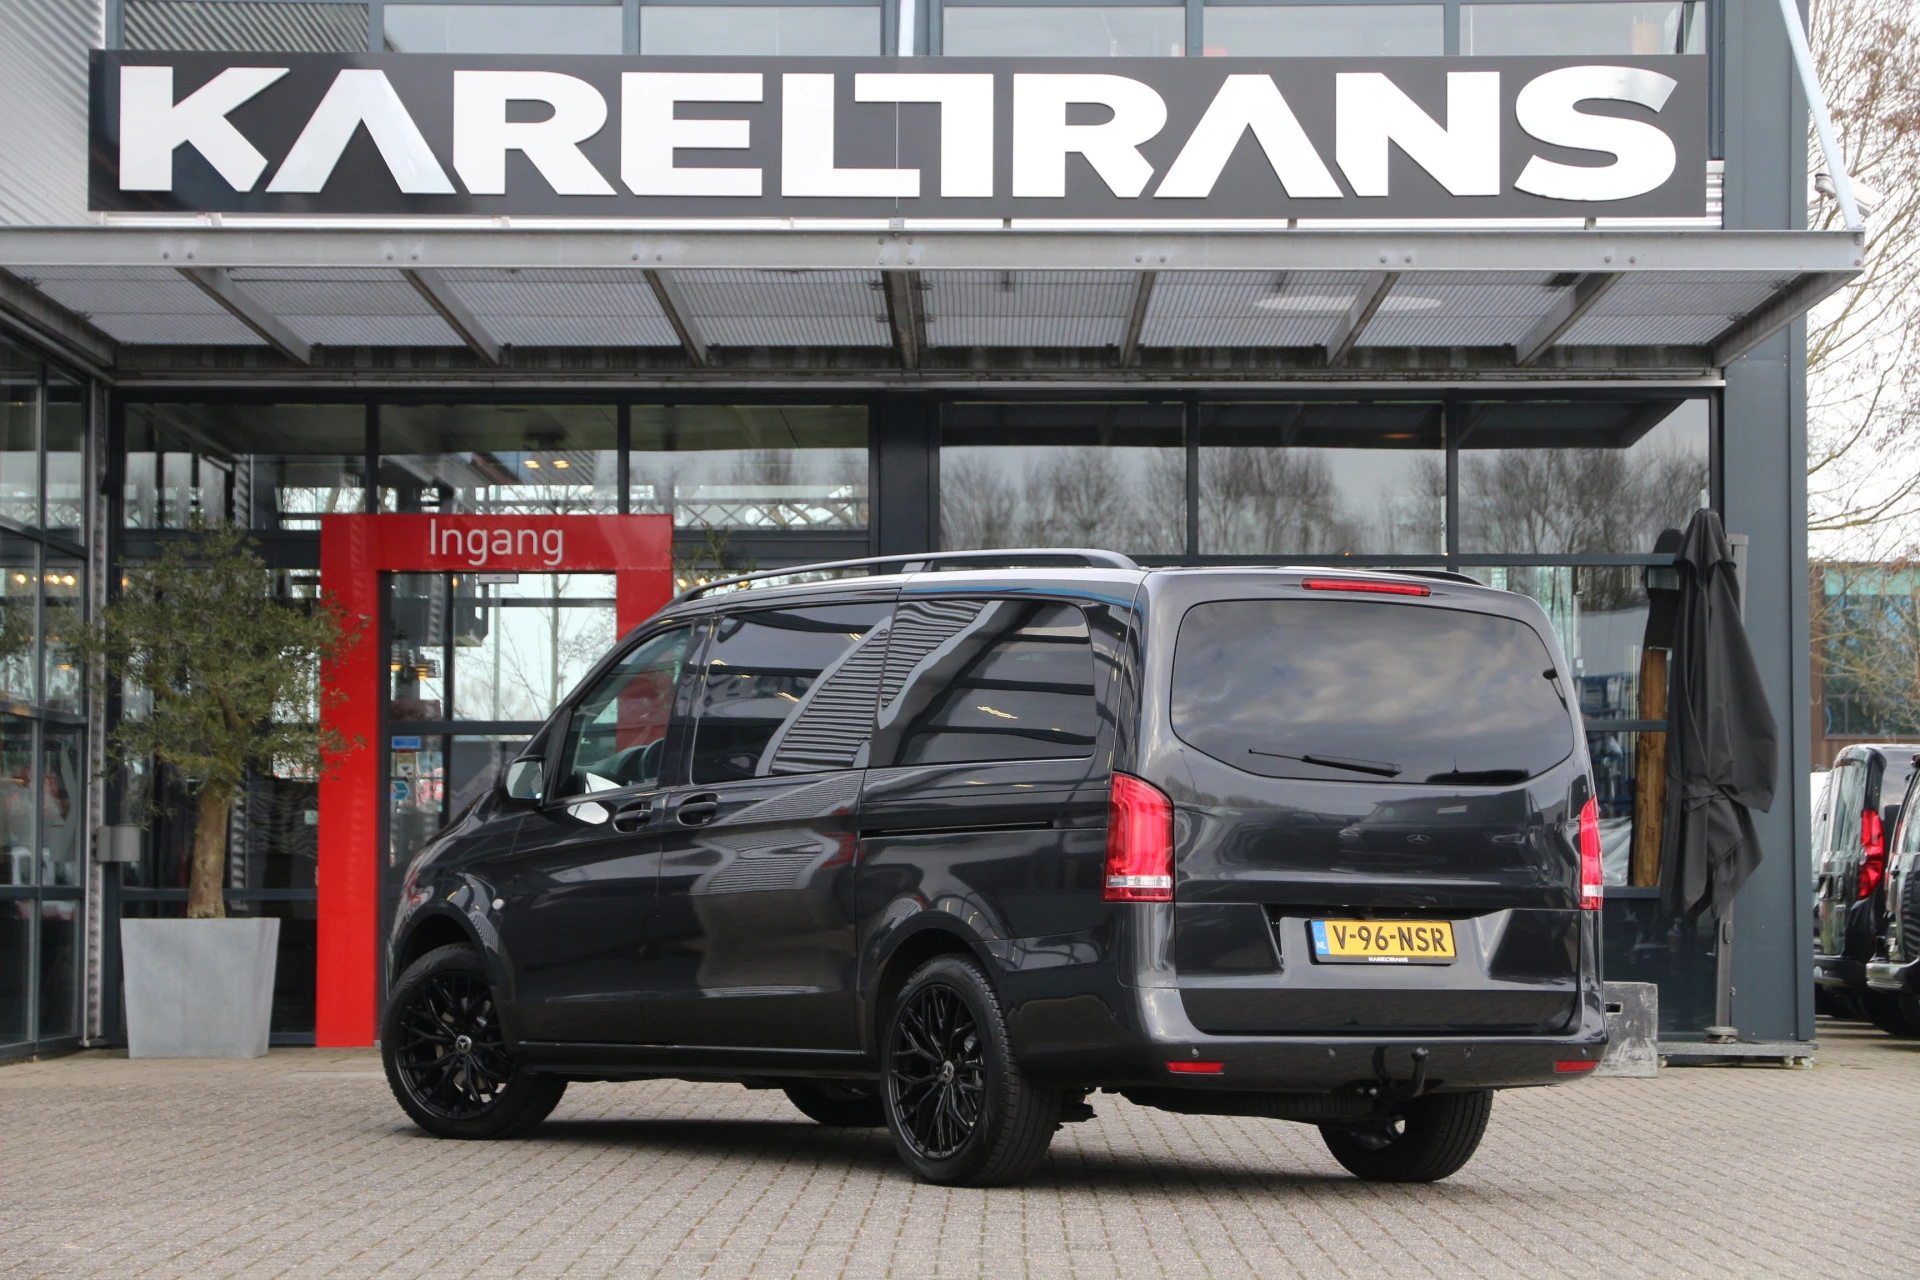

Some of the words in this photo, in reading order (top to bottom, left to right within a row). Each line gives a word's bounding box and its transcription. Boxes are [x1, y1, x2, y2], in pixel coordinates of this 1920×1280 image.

[119, 65, 1678, 200] KARELTRANS
[430, 518, 563, 566] Ingang
[1316, 941, 1327, 950] NL
[1333, 924, 1447, 952] V-96-NSR
